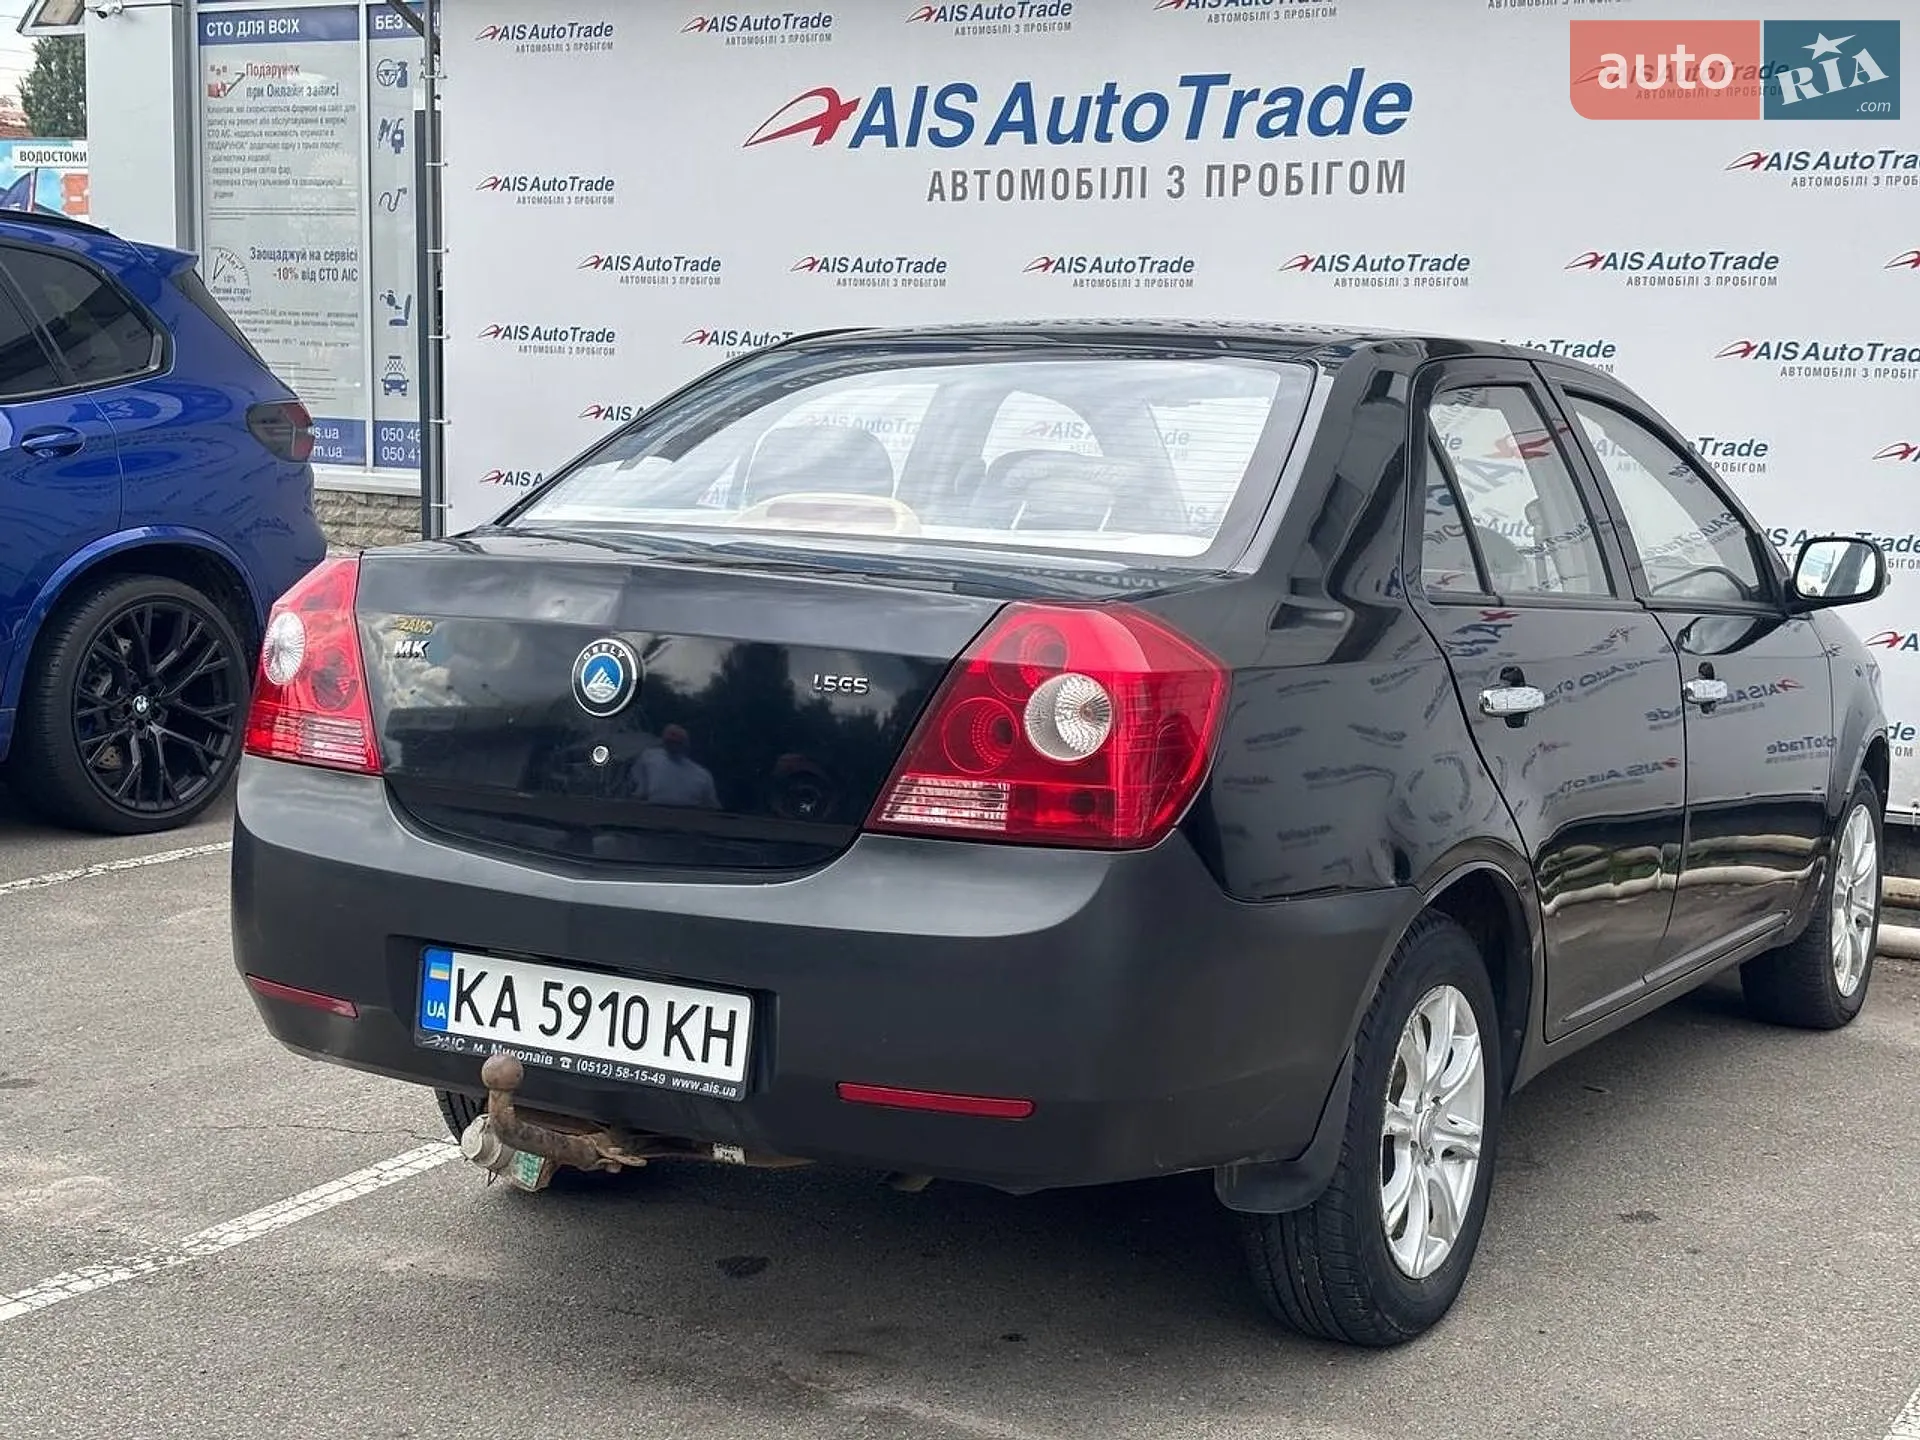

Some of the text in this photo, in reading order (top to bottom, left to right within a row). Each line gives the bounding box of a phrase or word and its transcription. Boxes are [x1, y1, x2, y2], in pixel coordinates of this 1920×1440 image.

[934, 4, 968, 22] AIS
[1207, 12, 1270, 23] АВТОМОБІЛІ
[1284, 8, 1337, 18] ПРОБІГОМ
[206, 18, 300, 38] СТО ДЛЯ ВСІХ
[375, 14, 403, 30] БЕЗ
[707, 15, 738, 32] AIS
[954, 24, 1010, 35] АВТОМОБІЛІ
[1024, 22, 1071, 32] ПРОБІГОМ
[499, 24, 527, 41] AIS
[725, 35, 776, 45] АВТОМОБІЛІ
[788, 33, 832, 43] ПРОБІГОМ
[848, 68, 1413, 149] AIS AutoTrade
[19, 150, 87, 164] ВОДОСТОКИ
[1764, 150, 1920, 171] AIS AutoTra
[500, 176, 528, 191] AIS
[927, 160, 1406, 202] АВТОМОБІЛІ З ПРОБІГОМ
[1791, 176, 1868, 187] АВТОМОБІЛІ
[602, 255, 631, 271] AIS
[817, 257, 850, 273] AIS
[1052, 256, 1087, 273] AIS
[1311, 254, 1350, 272] AIS
[1601, 252, 1645, 270] AIS
[273, 266, 299, 282] -10%
[320, 268, 339, 282] СТО
[342, 268, 359, 282] АІС
[1626, 276, 1699, 286] АВТОМОБІЛІ
[1715, 276, 1778, 286] ПРОБІГОМ
[836, 279, 890, 288] АВТОМОБІЛІ
[901, 279, 946, 288] ПРОБІГОМ
[1072, 279, 1131, 288] АВТОМОБІЛІ
[1144, 279, 1193, 288] ПРОБІГОМ
[1333, 277, 1399, 288] АВТОМОБІЛІ
[1413, 277, 1468, 288] ПРОБІГОМ
[500, 325, 529, 341] AIS
[707, 330, 738, 346] AIS
[1753, 341, 1800, 361] AIS
[1780, 367, 1856, 378] АВТОМОБІЛІ
[603, 405, 632, 420] AIS
[381, 427, 404, 442] 050
[383, 446, 405, 461] 050
[1711, 461, 1766, 473] РОБІГОМ
[502, 471, 531, 486] AIS
[394, 640, 431, 659] MK
[427, 1000, 447, 1020] UA
[454, 968, 738, 1067] KA 5910 KH
[577, 1058, 613, 1078] (0512)
[615, 1065, 666, 1087] 58-15-49
[671, 1075, 737, 1099] www.ais.ua
